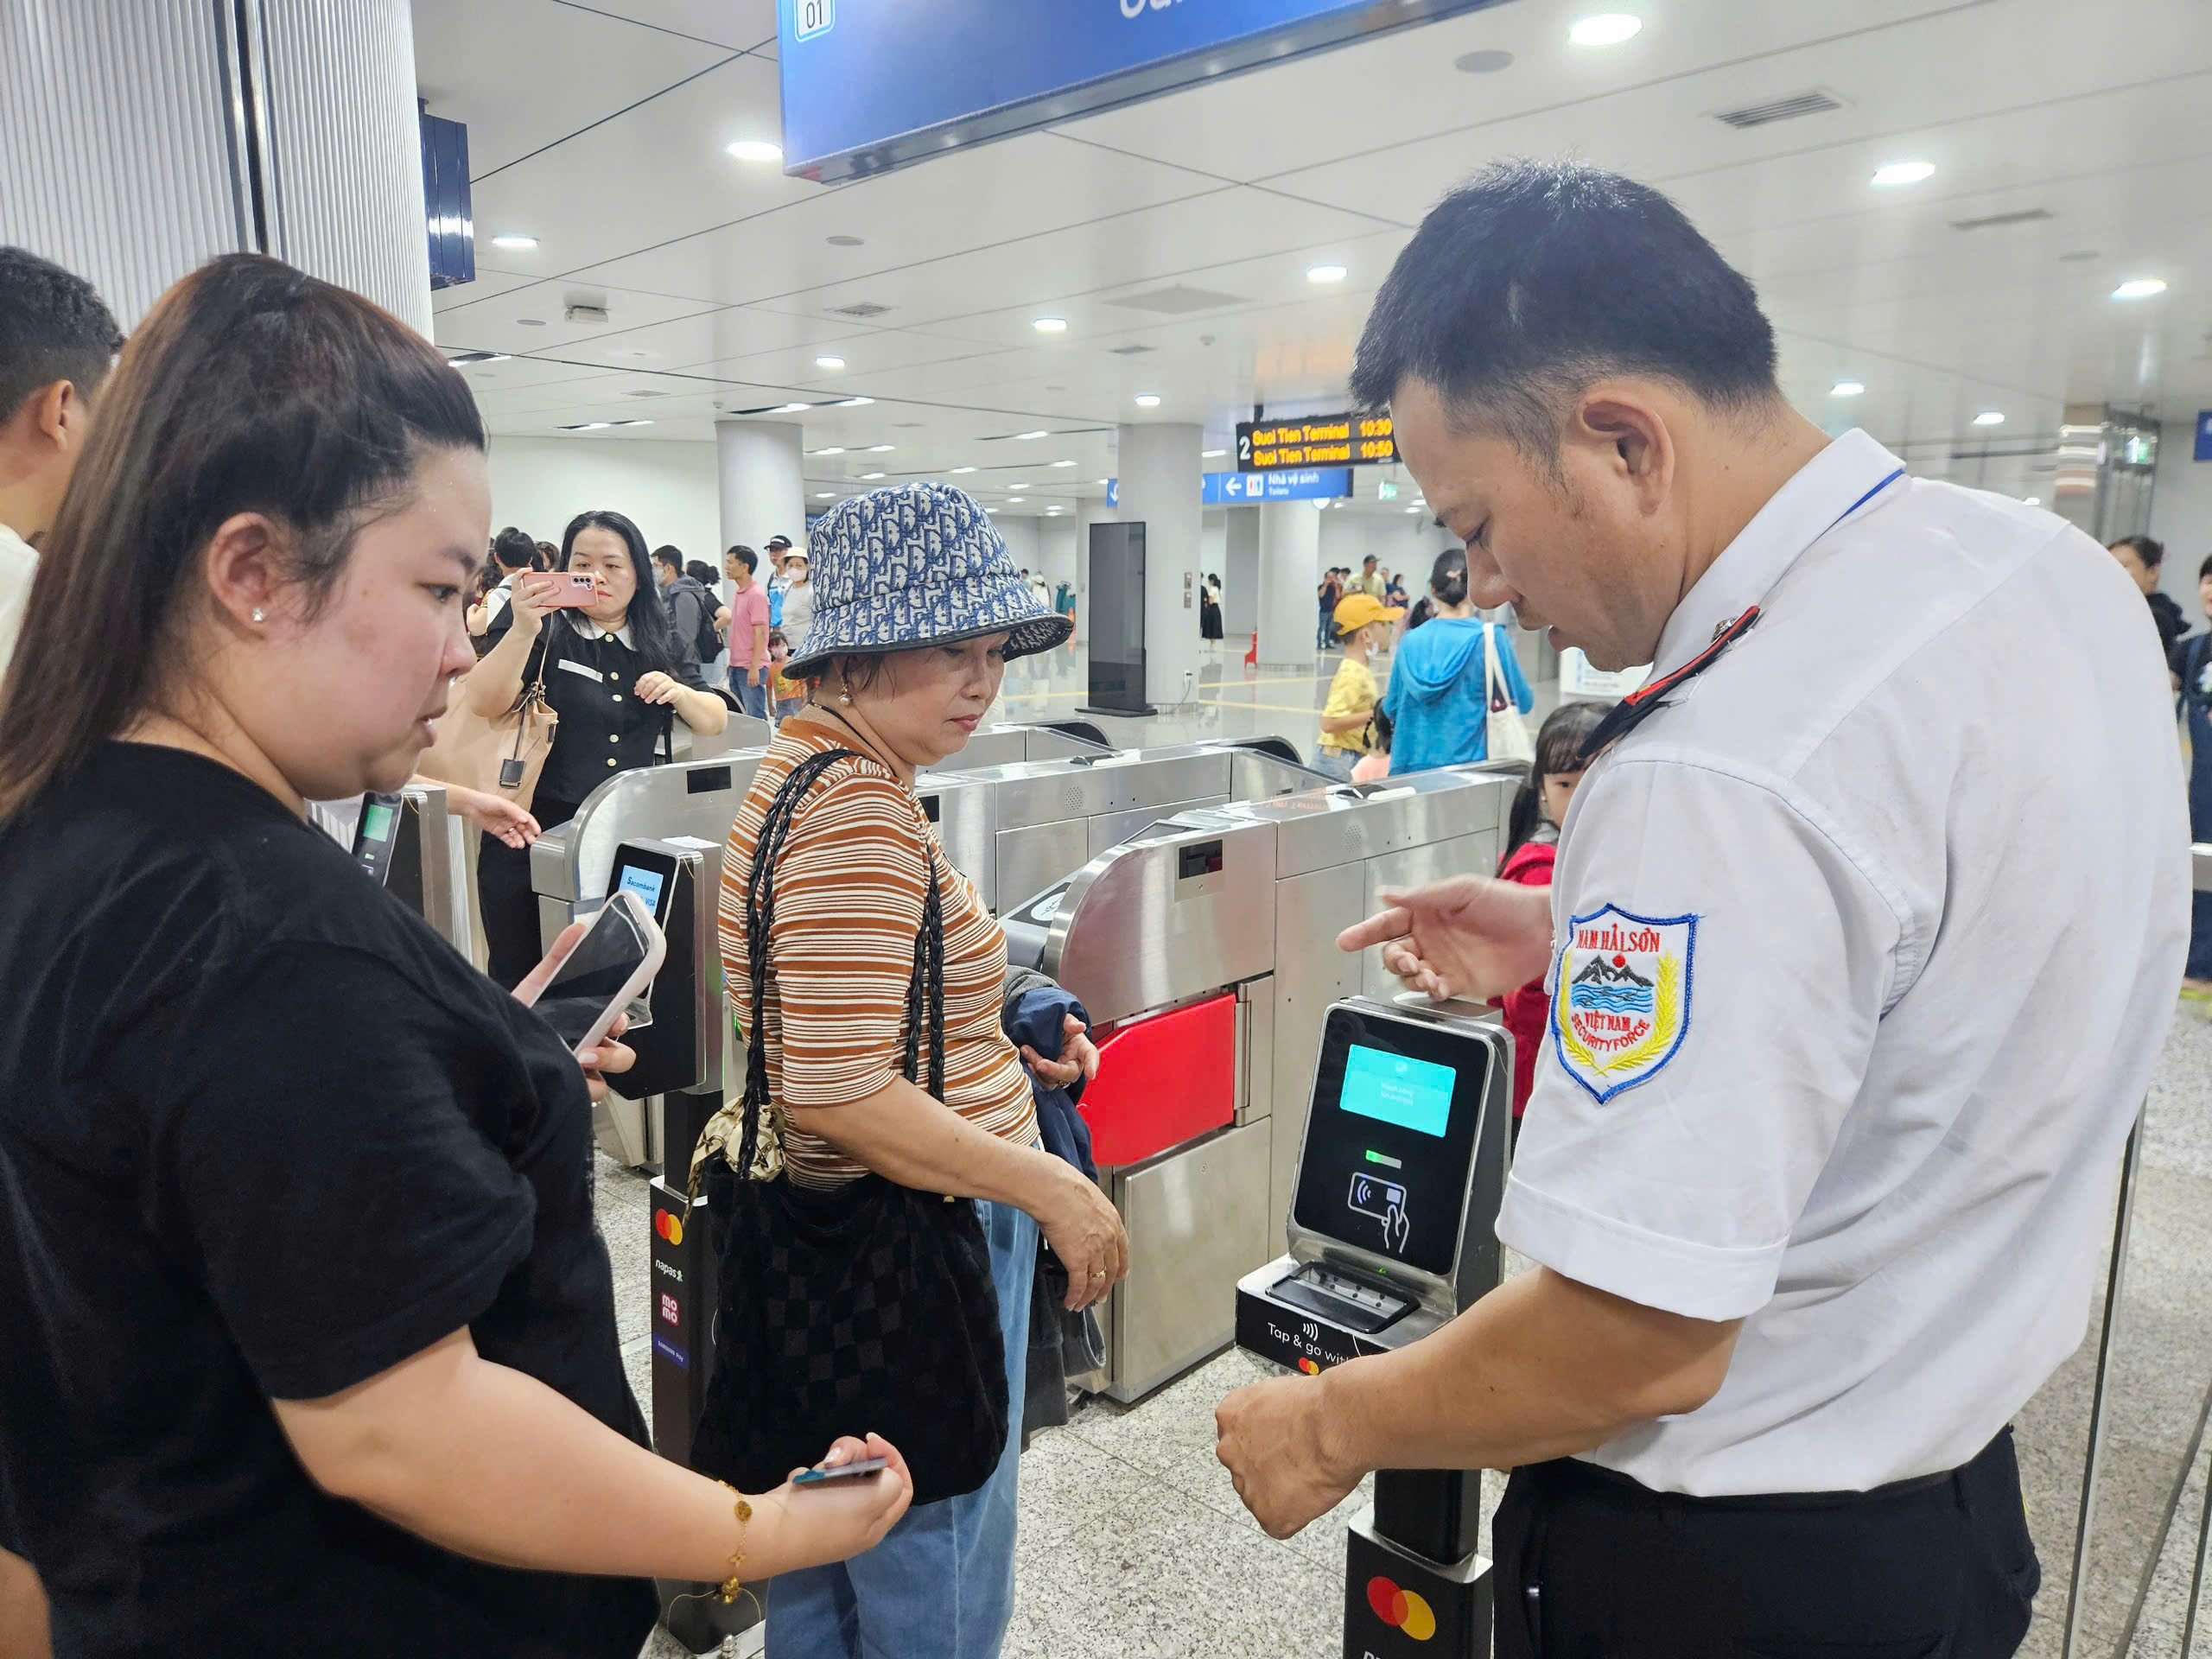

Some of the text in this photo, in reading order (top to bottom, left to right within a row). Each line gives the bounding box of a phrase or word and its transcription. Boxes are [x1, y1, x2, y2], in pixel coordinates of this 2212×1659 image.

[805, 0, 823, 29] 01
[1302, 422, 1350, 442] Terminal
[1239, 435, 1251, 460] 2
[1303, 442, 1351, 463] Terminal
[627, 876, 656, 892] Sacombank
[1576, 923, 1661, 952] NAM HẢI SƠN
[1585, 1009, 1631, 1032] VIỆT NAM
[655, 1259, 677, 1278] napas
[662, 1294, 677, 1312] mo
[662, 1306, 677, 1324] mo
[1268, 1322, 1290, 1344] Tap
[1293, 1334, 1302, 1348] &
[1306, 1343, 1322, 1356] go
